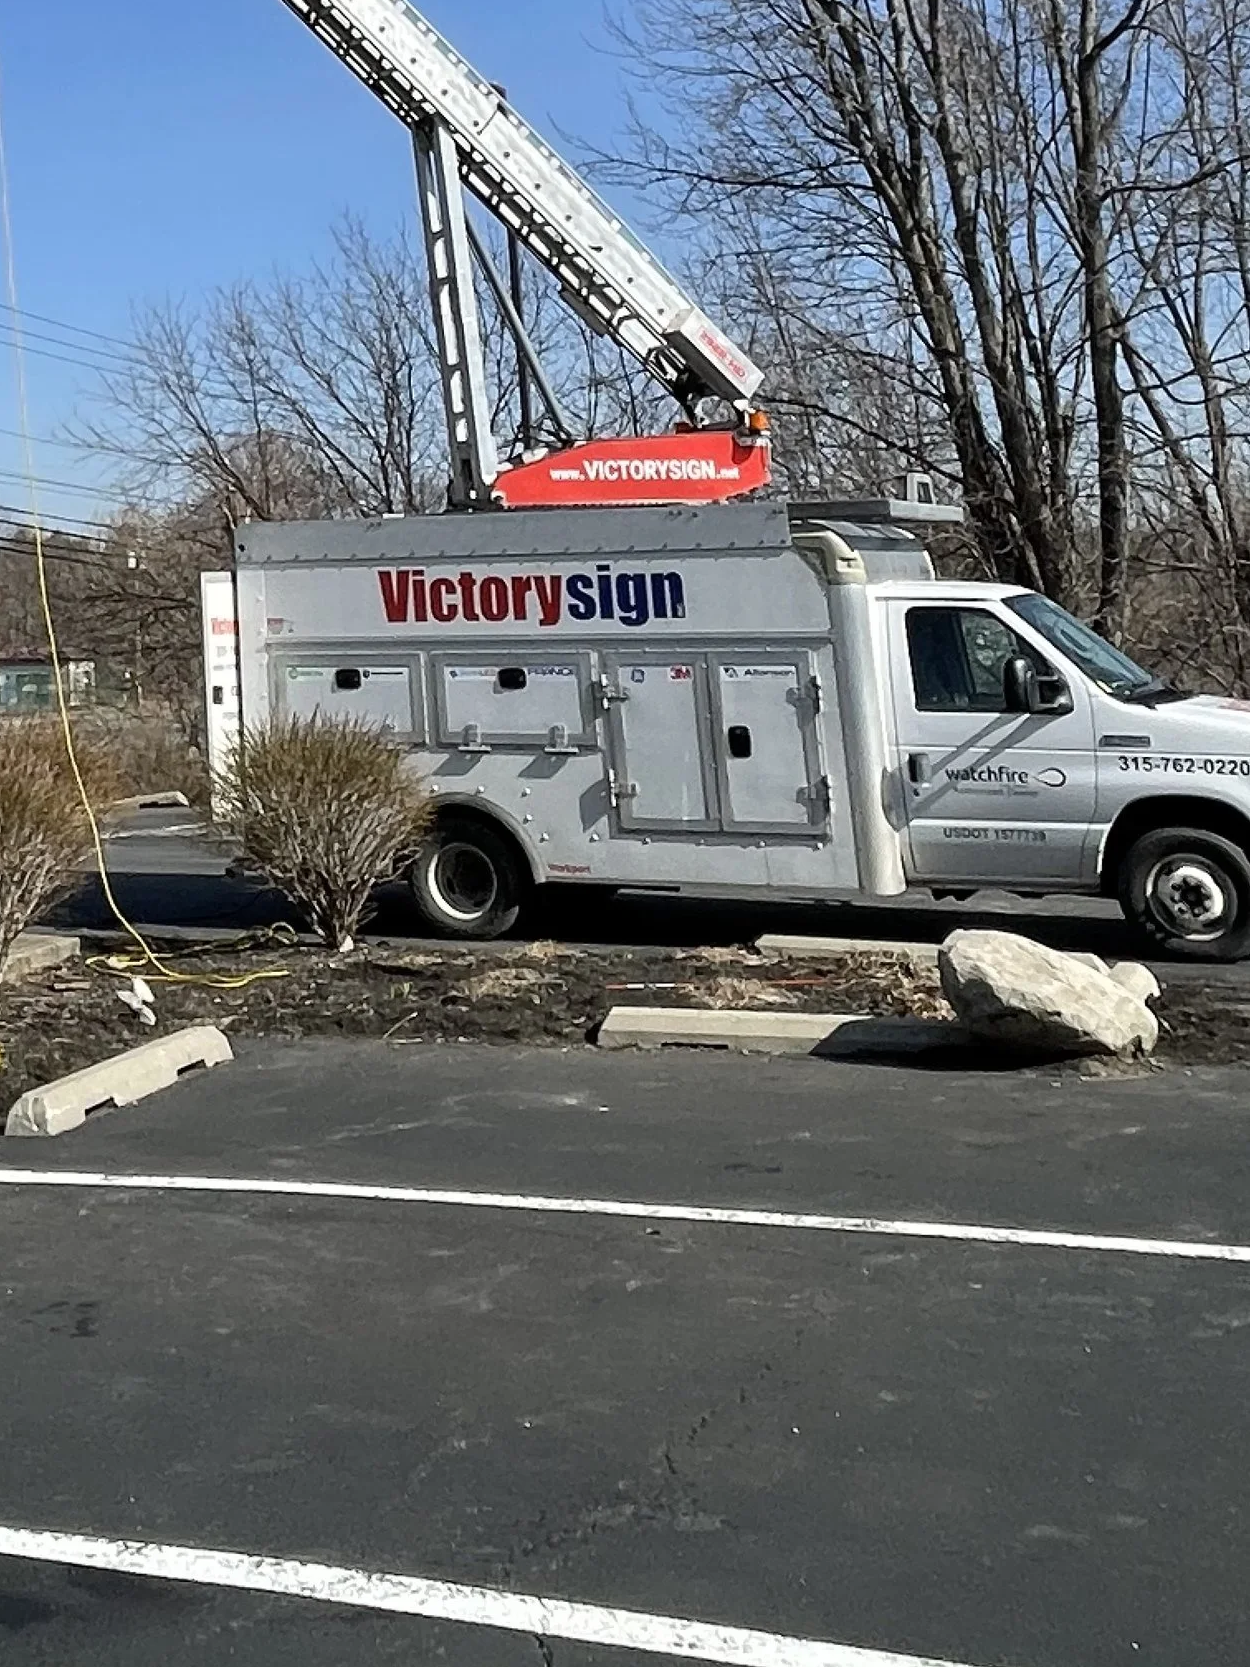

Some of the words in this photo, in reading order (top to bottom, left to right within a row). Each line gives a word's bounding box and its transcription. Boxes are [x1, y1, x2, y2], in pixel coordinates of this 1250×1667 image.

[550, 459, 739, 481] www.VICTORYSIGN.net
[378, 564, 686, 627] Victorysign
[670, 666, 692, 679] 3M
[945, 766, 1028, 783] watchfire
[1118, 756, 1250, 776] 315-762-0220
[943, 828, 989, 839] USDOT
